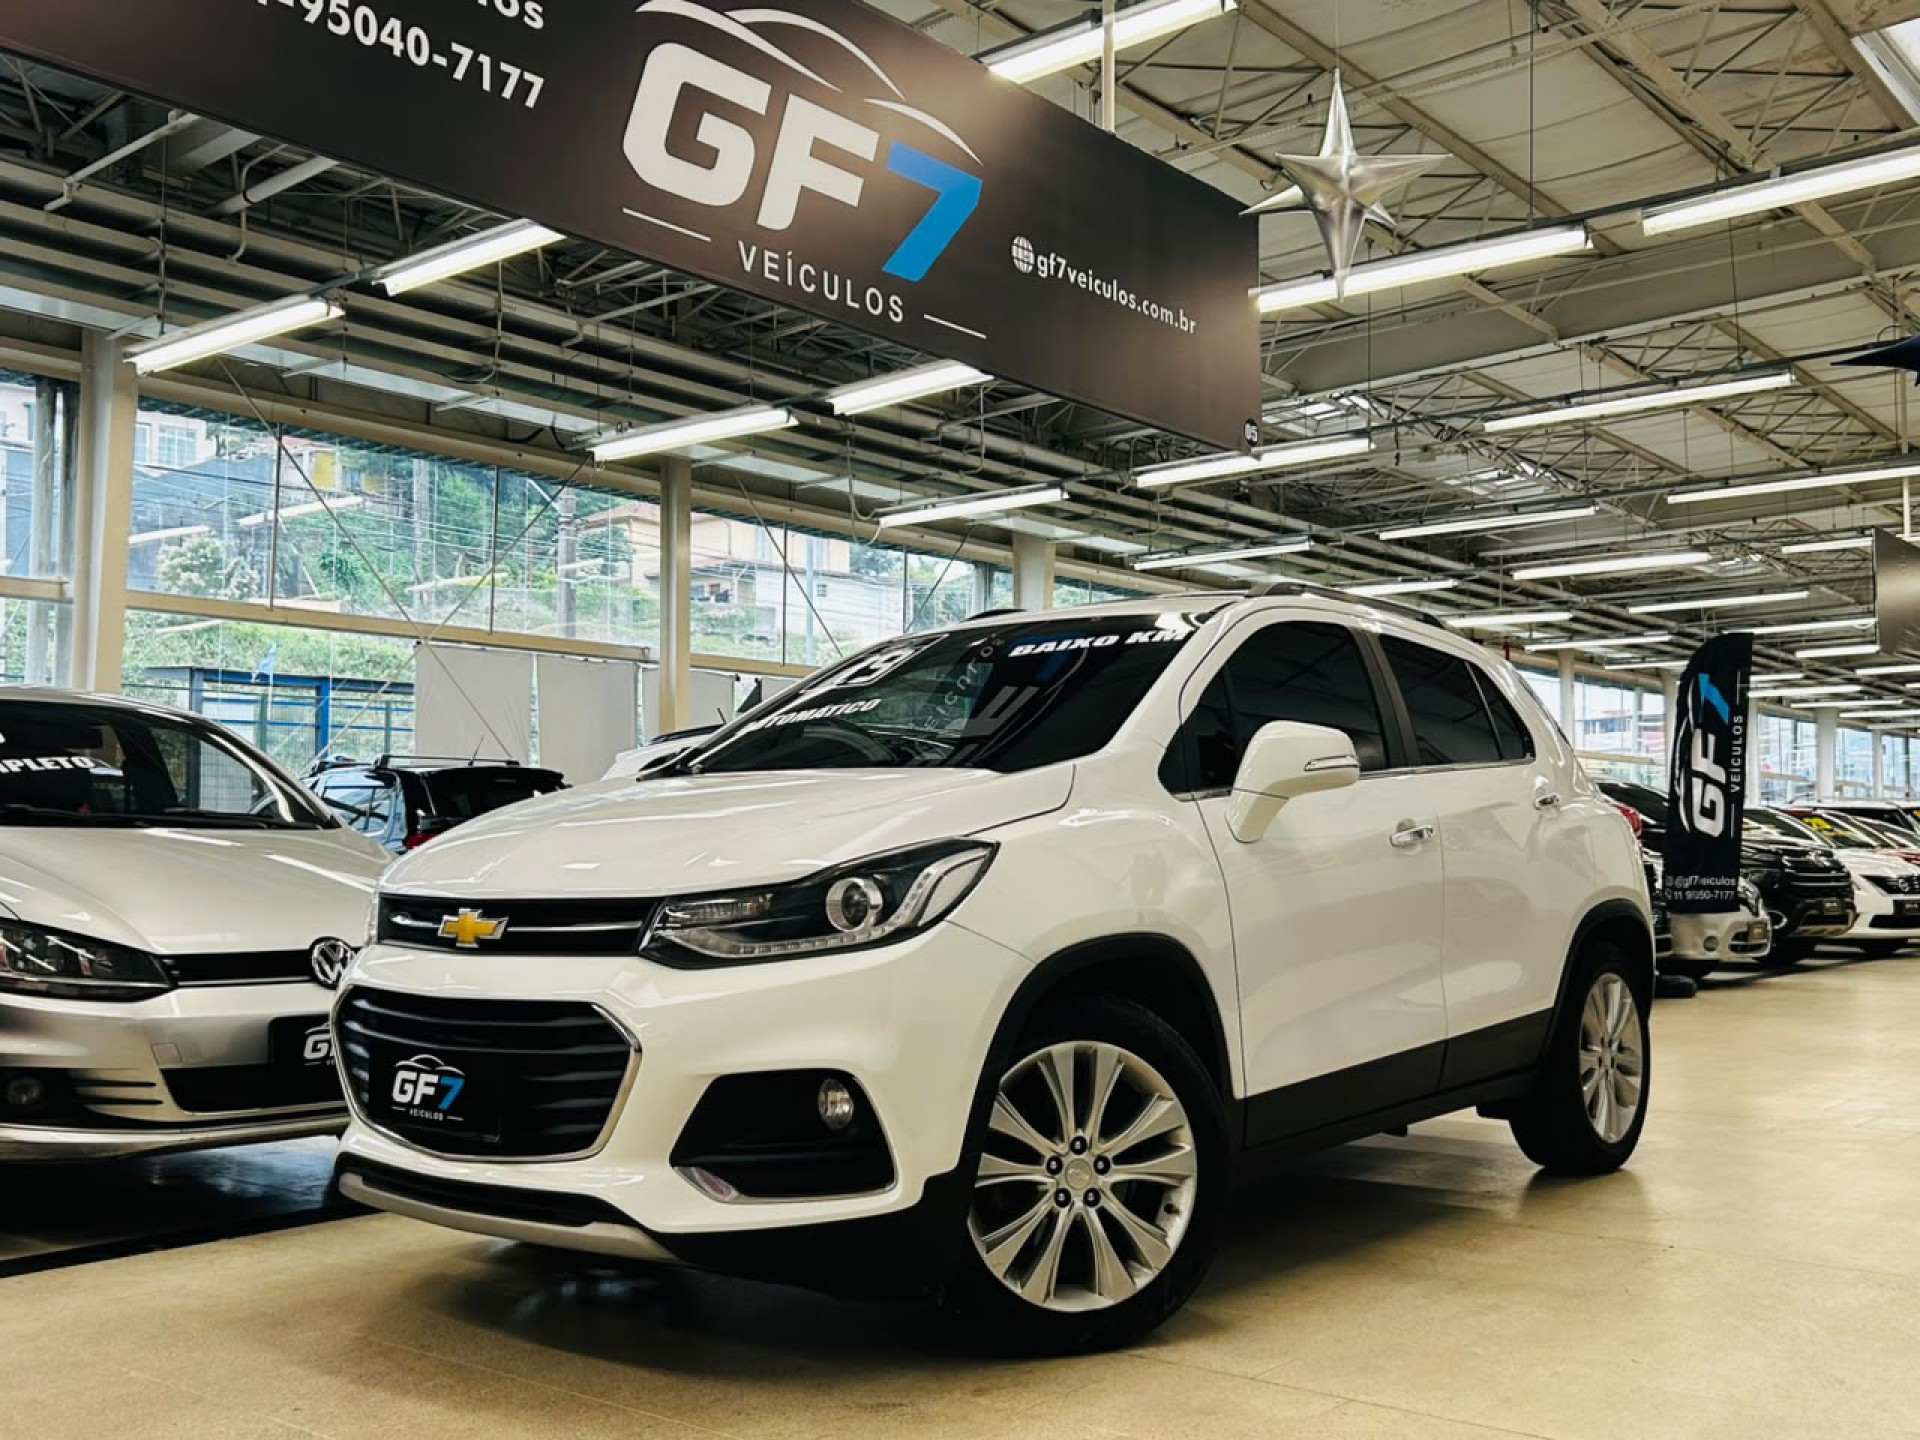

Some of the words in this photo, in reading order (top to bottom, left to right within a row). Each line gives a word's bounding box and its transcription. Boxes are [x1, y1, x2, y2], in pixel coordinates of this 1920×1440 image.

[623, 42, 983, 283] GF7
[737, 240, 904, 323] VEÍCULOS
[1037, 252, 1197, 334] gf7veiculos.com.br
[1008, 634, 1120, 657] BAIXO
[1124, 628, 1187, 644] KM
[1691, 672, 1730, 838] GF7
[303, 1032, 337, 1060] G
[392, 1070, 466, 1111] GF7
